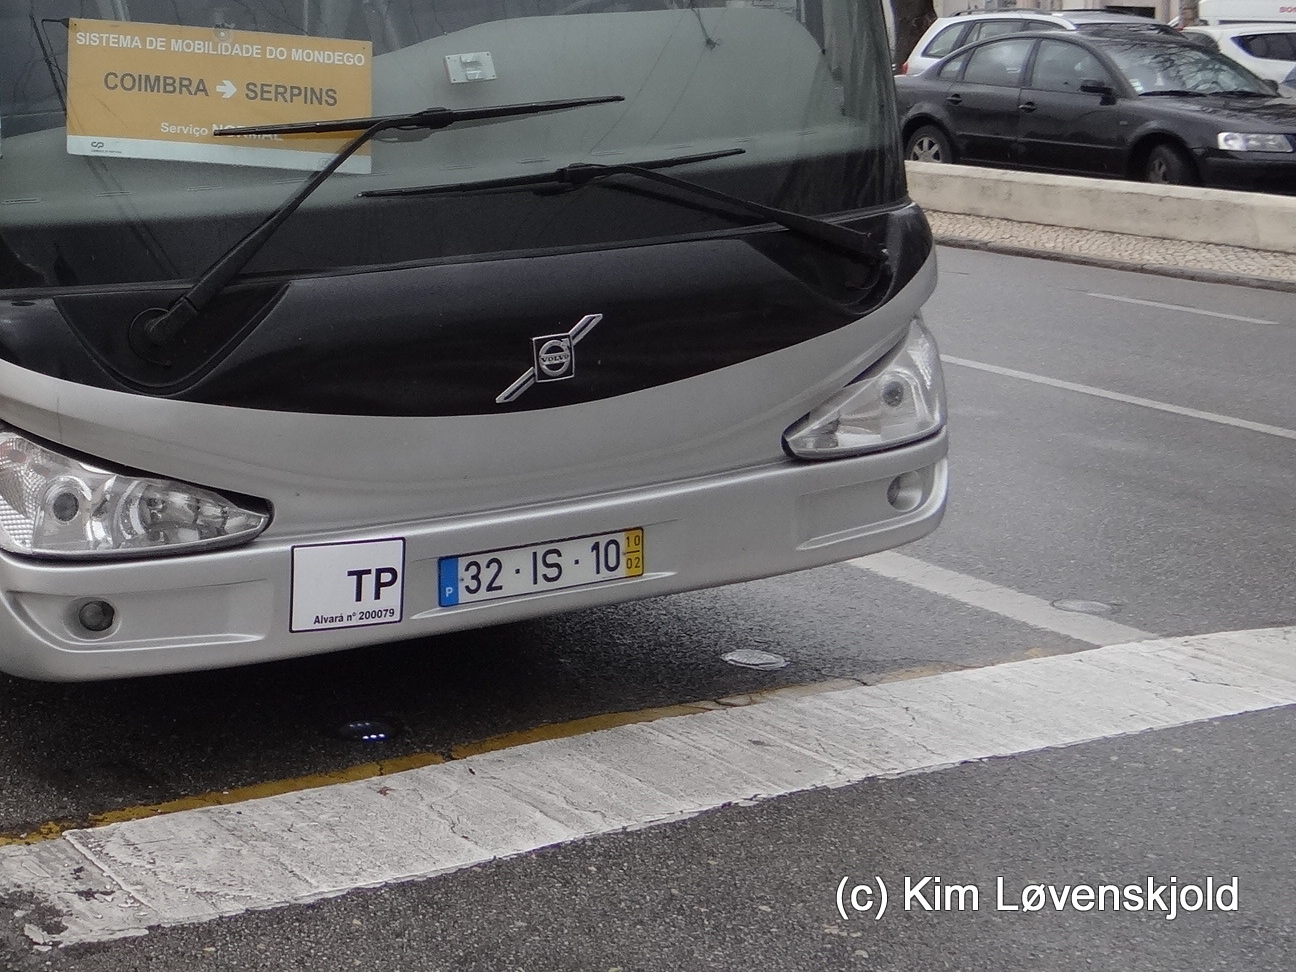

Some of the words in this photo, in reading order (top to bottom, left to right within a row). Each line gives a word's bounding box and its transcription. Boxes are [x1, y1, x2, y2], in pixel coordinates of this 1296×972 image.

[76, 32, 142, 49] SISTEMA
[146, 36, 166, 51] DE
[170, 38, 261, 58] MOBILIDADE
[266, 46, 287, 60] DO
[291, 48, 365, 66] MONDEGO
[104, 71, 209, 97] COIMBRA
[245, 81, 337, 107] SERPINS
[160, 122, 208, 137] Serviço
[541, 353, 569, 362] VOLVO
[626, 534, 640, 548] 10
[626, 557, 640, 569] 02
[347, 566, 398, 603] TP
[445, 586, 453, 597] P
[313, 613, 344, 625] Alvará
[358, 608, 395, 621] 200079
